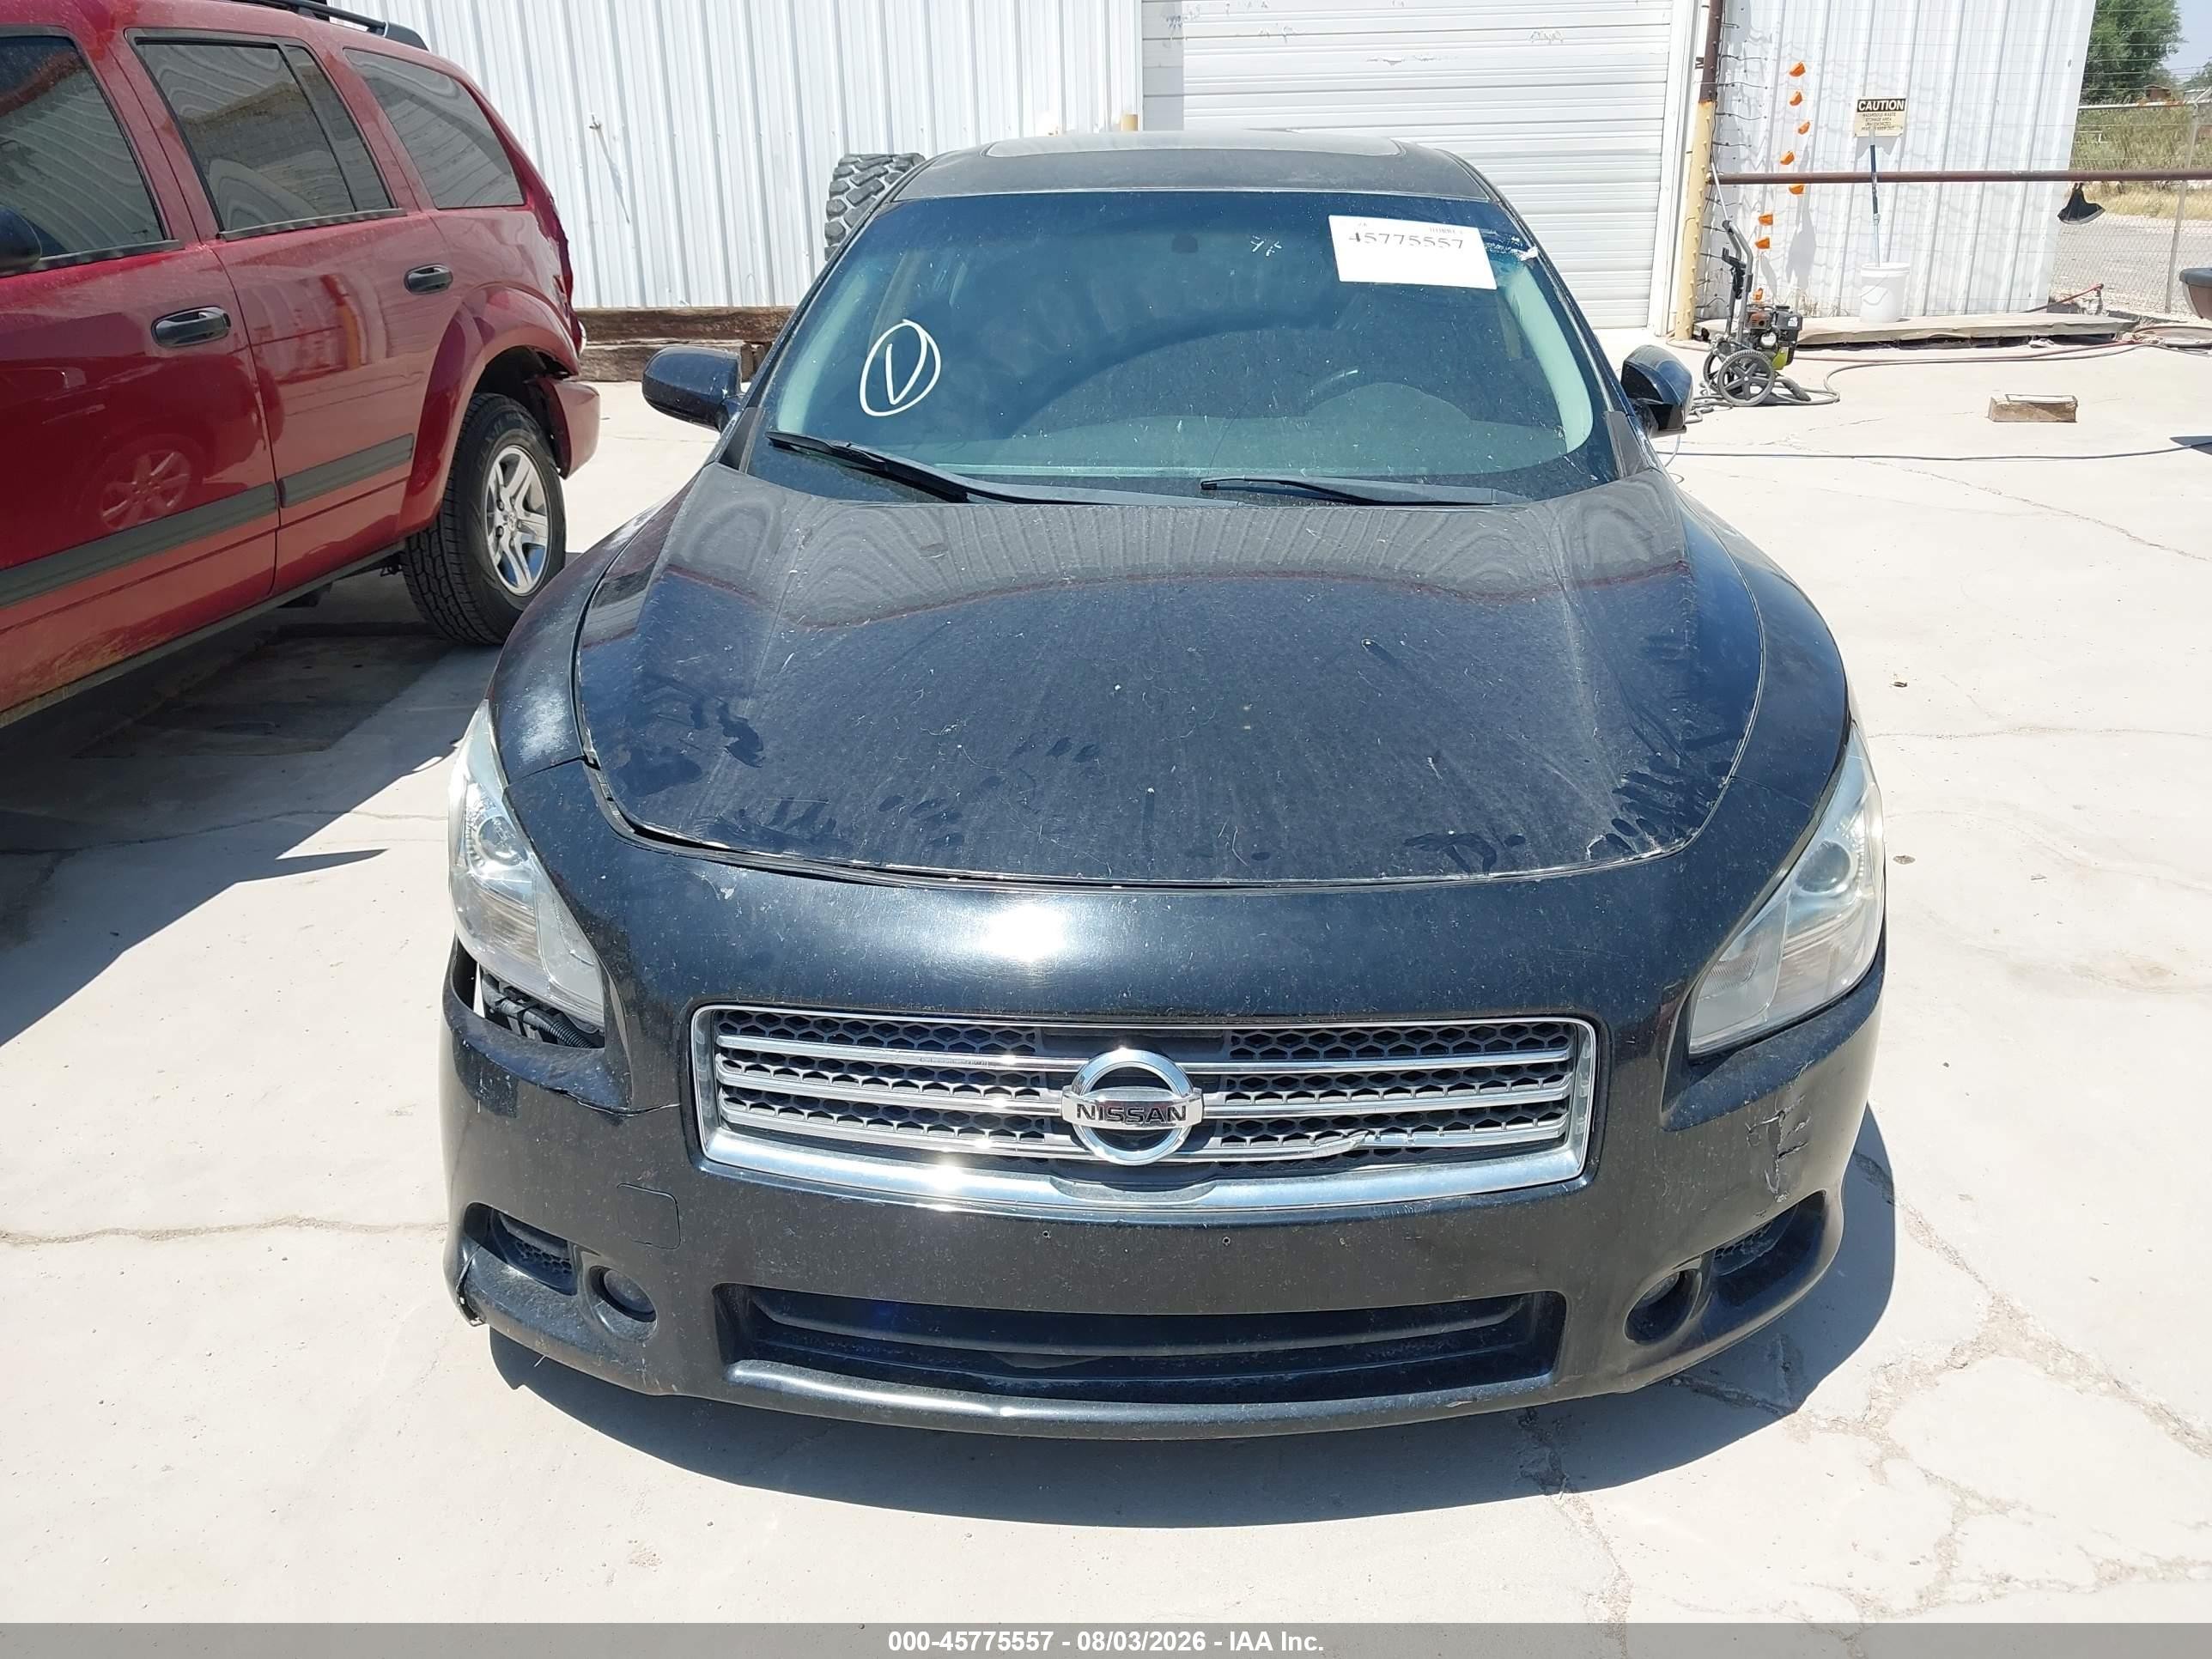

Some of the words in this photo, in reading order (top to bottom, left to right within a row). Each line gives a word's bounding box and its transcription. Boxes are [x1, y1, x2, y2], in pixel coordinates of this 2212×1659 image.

[1858, 100, 1905, 111] CAUTION
[1349, 232, 1464, 249] 45775557
[1076, 1103, 1188, 1124] NISSAN
